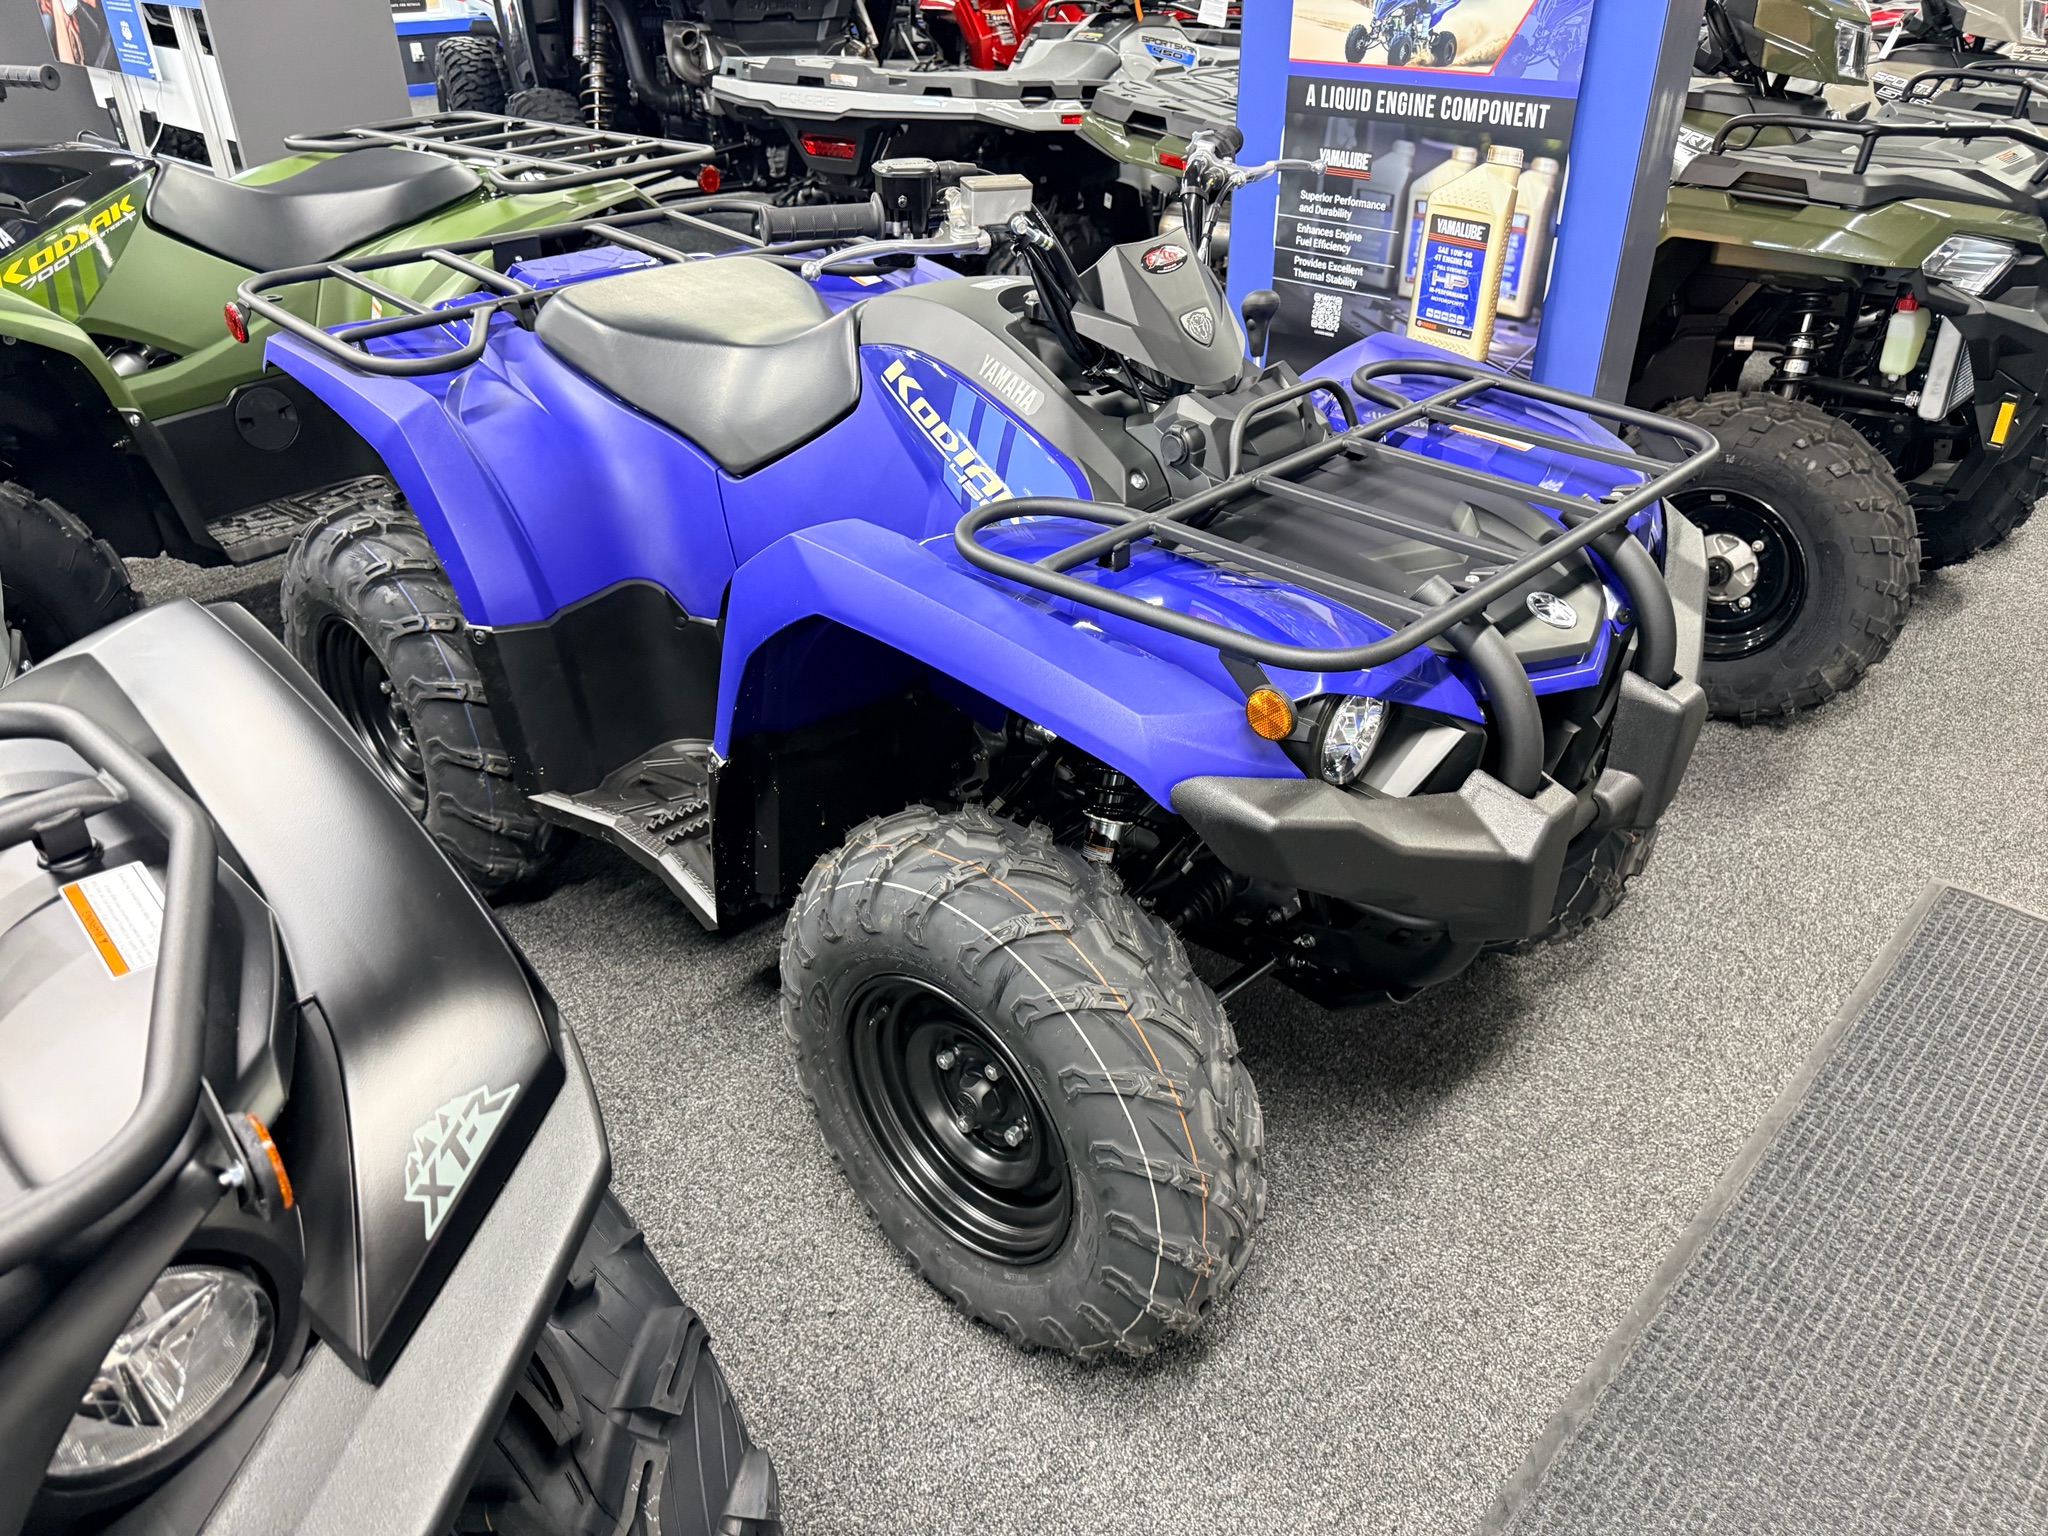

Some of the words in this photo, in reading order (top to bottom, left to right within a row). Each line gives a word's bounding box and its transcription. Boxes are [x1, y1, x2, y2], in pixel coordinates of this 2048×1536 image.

[1152, 46, 1183, 60] 450
[779, 91, 838, 108] POLARIS
[1305, 83, 1316, 107] A
[1320, 85, 1372, 114] LIQUID
[1376, 90, 1435, 118] ENGINE
[1440, 96, 1551, 129] COMPONENT
[1319, 147, 1371, 171] YAMALUBE
[1300, 190, 1333, 204] Superior
[1334, 194, 1387, 211] Performance
[1299, 204, 1313, 213] and
[1314, 205, 1352, 221] Durability
[1296, 223, 1334, 238] Enhances
[1335, 229, 1362, 243] Engine
[1437, 218, 1484, 241] YAMALUBE
[0, 194, 135, 288] KODIAK
[1295, 236, 1312, 247] Fuel
[1313, 239, 1351, 255] Efficiency
[1434, 254, 1442, 262] 4T
[1442, 255, 1463, 266] ENGINE
[1463, 259, 1473, 268] OIL
[1437, 246, 1449, 255] SAE
[1450, 248, 1473, 260] 10W-40
[20, 255, 70, 291] 700
[1293, 255, 1327, 270] Provides
[1328, 261, 1363, 276] Excellent
[1293, 268, 1325, 282] Thermal
[1325, 274, 1357, 289] Stability
[1431, 270, 1469, 290] HP
[978, 354, 1038, 412] YAMAHA
